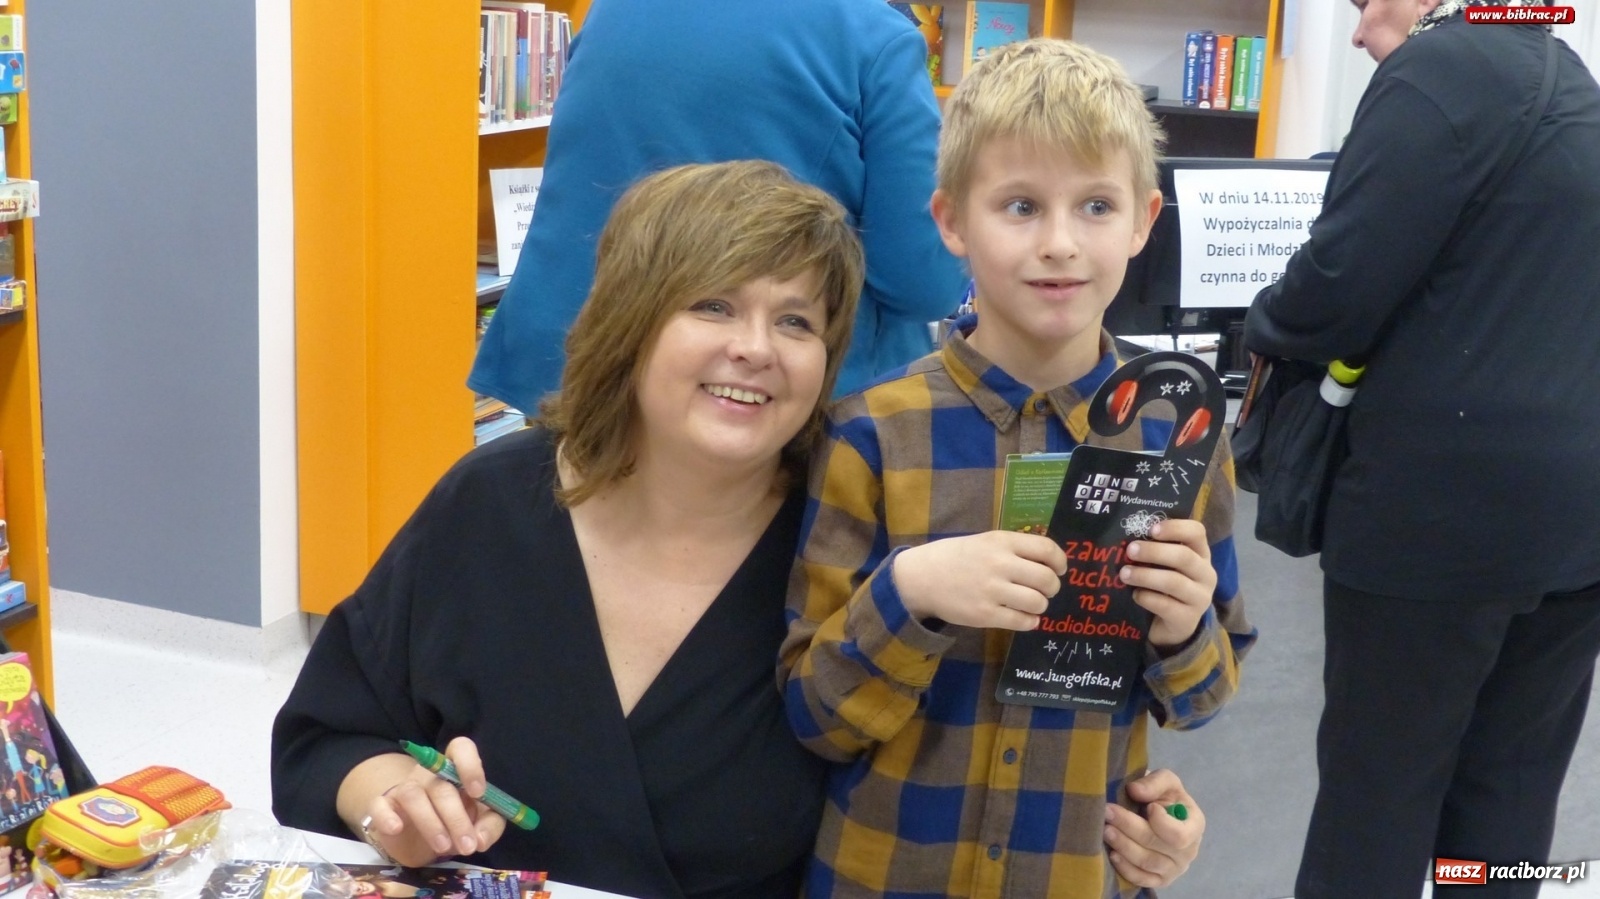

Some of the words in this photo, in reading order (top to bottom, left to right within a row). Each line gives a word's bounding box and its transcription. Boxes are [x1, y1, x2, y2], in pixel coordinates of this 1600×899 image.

[1199, 191, 1214, 204] W
[1219, 191, 1249, 204] dniu
[1254, 191, 1324, 205] 14.11.2019
[1203, 216, 1303, 233] Wypożyczalnia
[1206, 243, 1246, 257] Dzieci
[1250, 243, 1253, 256] i
[1257, 243, 1303, 257] Młodz
[1200, 272, 1246, 286] czynna
[1250, 269, 1267, 282] do
[1084, 473, 1138, 491] JUNG
[1077, 486, 1118, 501] OFF
[1075, 501, 1110, 514] SKA
[1079, 593, 1110, 613] na
[1034, 614, 1141, 640] udiobooku
[1015, 668, 1123, 690] www.jungoffska.pl
